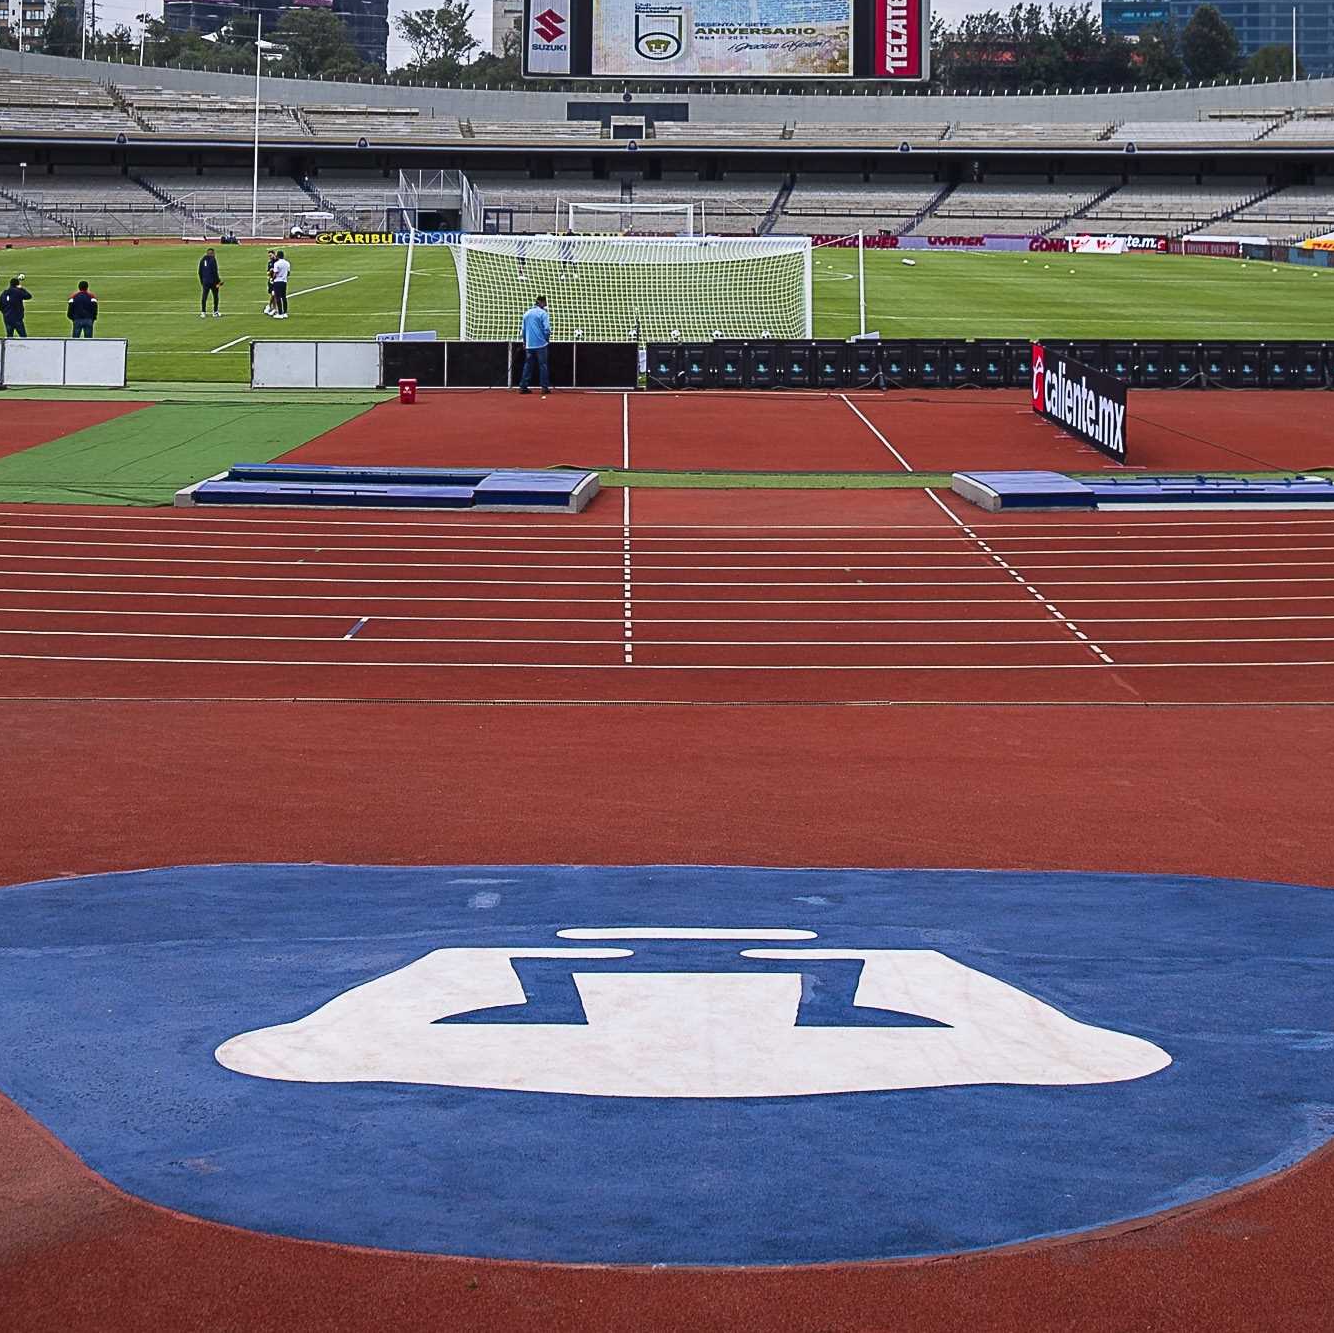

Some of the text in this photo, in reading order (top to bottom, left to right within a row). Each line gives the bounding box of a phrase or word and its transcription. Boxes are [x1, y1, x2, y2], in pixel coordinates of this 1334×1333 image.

[694, 27, 817, 35] ANIVERSARIO
[531, 43, 567, 51] SUZUKI
[332, 233, 393, 244] CARIBU
[1044, 361, 1125, 453] caliente.mx
